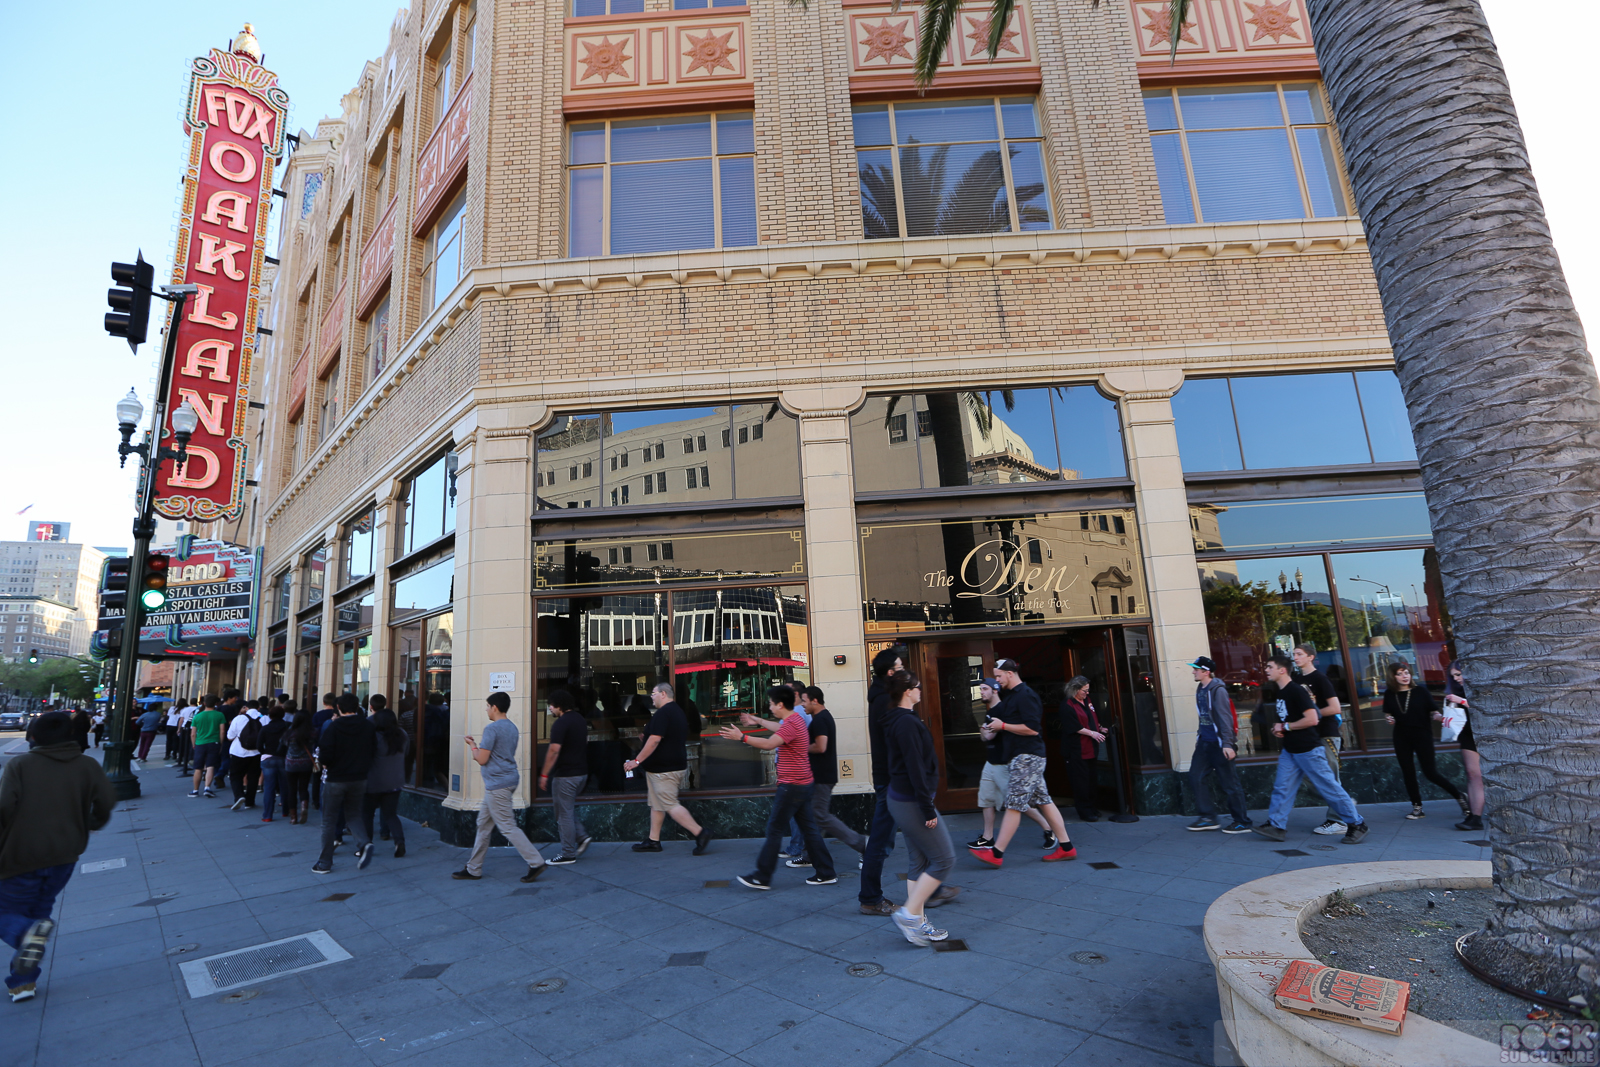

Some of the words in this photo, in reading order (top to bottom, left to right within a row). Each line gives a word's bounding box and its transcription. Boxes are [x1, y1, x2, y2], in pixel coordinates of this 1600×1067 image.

[204, 88, 274, 145] FOX
[167, 140, 257, 490] OAKLAND
[167, 562, 226, 583] LAND
[923, 569, 954, 588] The
[956, 538, 1079, 599] Den
[165, 587, 194, 599] STAL
[197, 582, 244, 596] CASTLES
[170, 597, 226, 612] SPOTLIGHT
[1013, 600, 1025, 610] at
[1028, 598, 1045, 609] the
[1047, 597, 1071, 610] Fox
[145, 614, 176, 627] ARMIN
[180, 612, 201, 624] VAN
[203, 609, 244, 621] BUUREN
[1321, 970, 1334, 992] PIZZA
[1328, 971, 1360, 1007] READY
